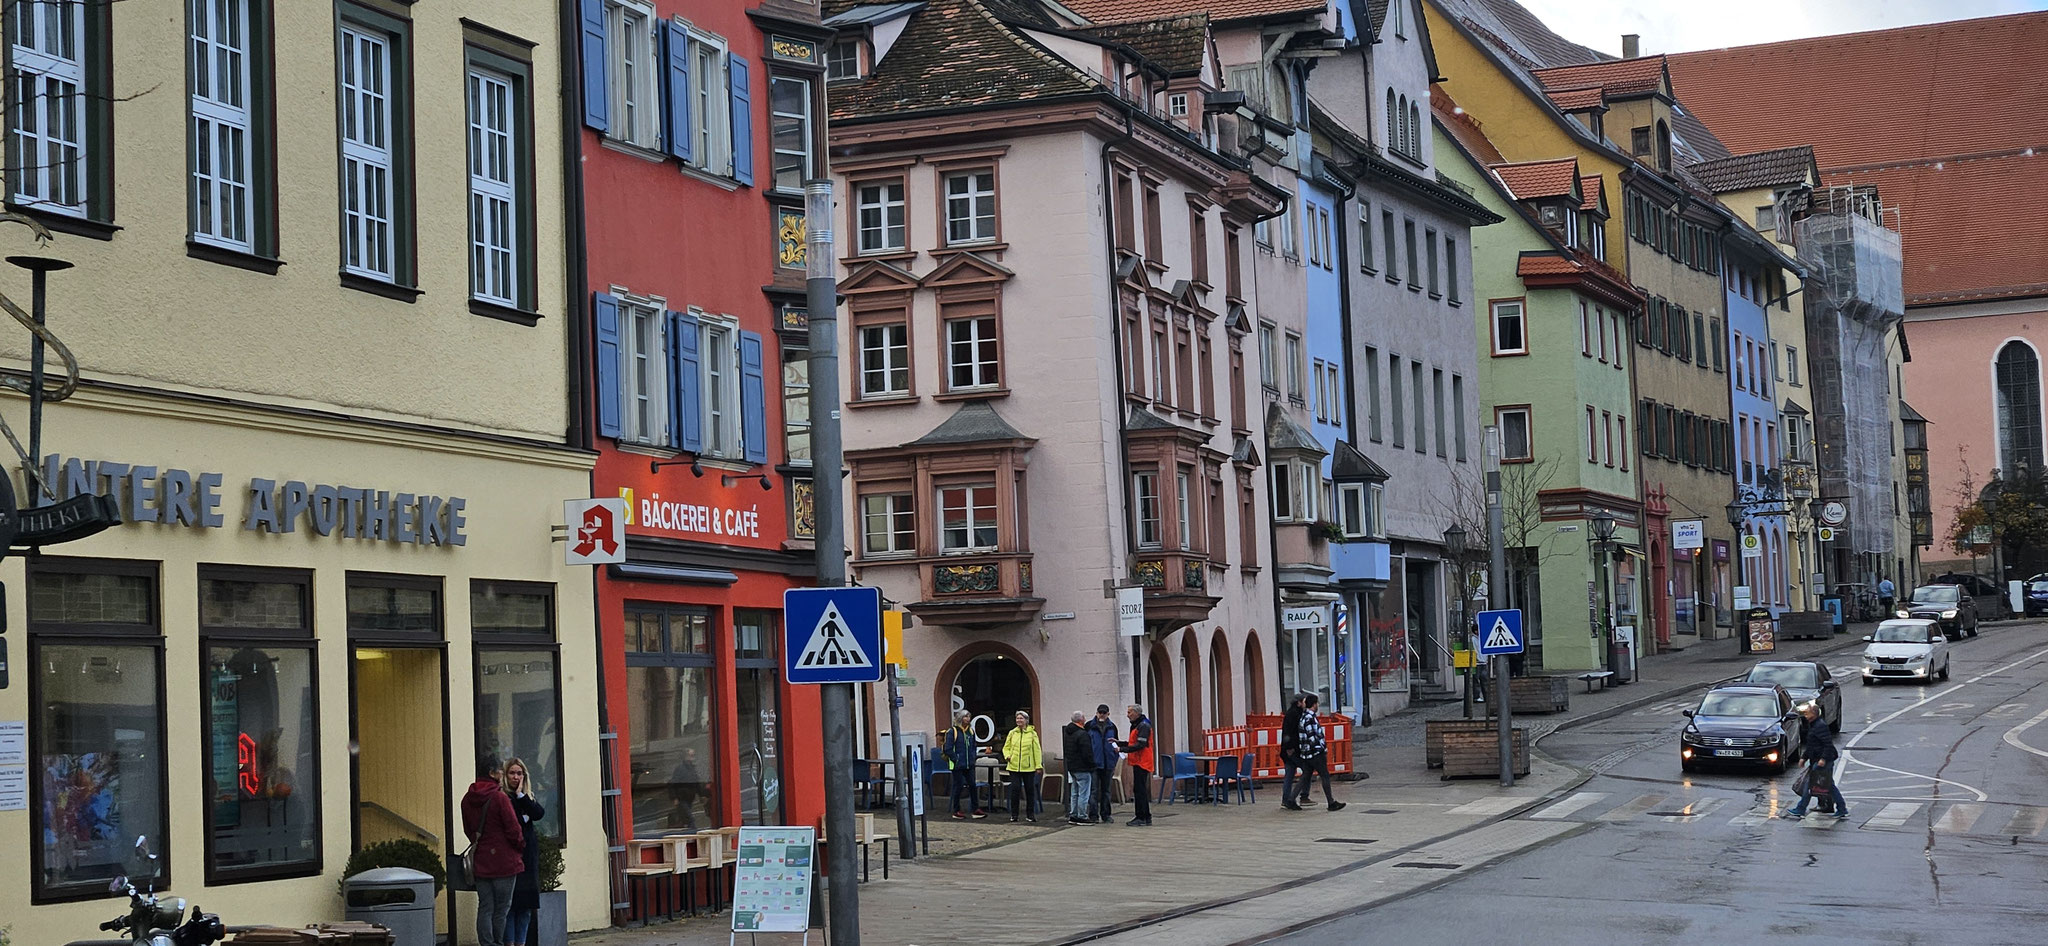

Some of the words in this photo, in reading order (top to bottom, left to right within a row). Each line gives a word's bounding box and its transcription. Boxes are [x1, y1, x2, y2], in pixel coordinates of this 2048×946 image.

[245, 477, 467, 547] APOTHEKE
[641, 493, 710, 534] BÄCKEREI
[712, 510, 723, 534] &
[724, 503, 759, 538] CAFÉ
[1678, 530, 1698, 538] SPORT
[1121, 603, 1142, 615] STORZ
[1287, 612, 1306, 622] RAU
